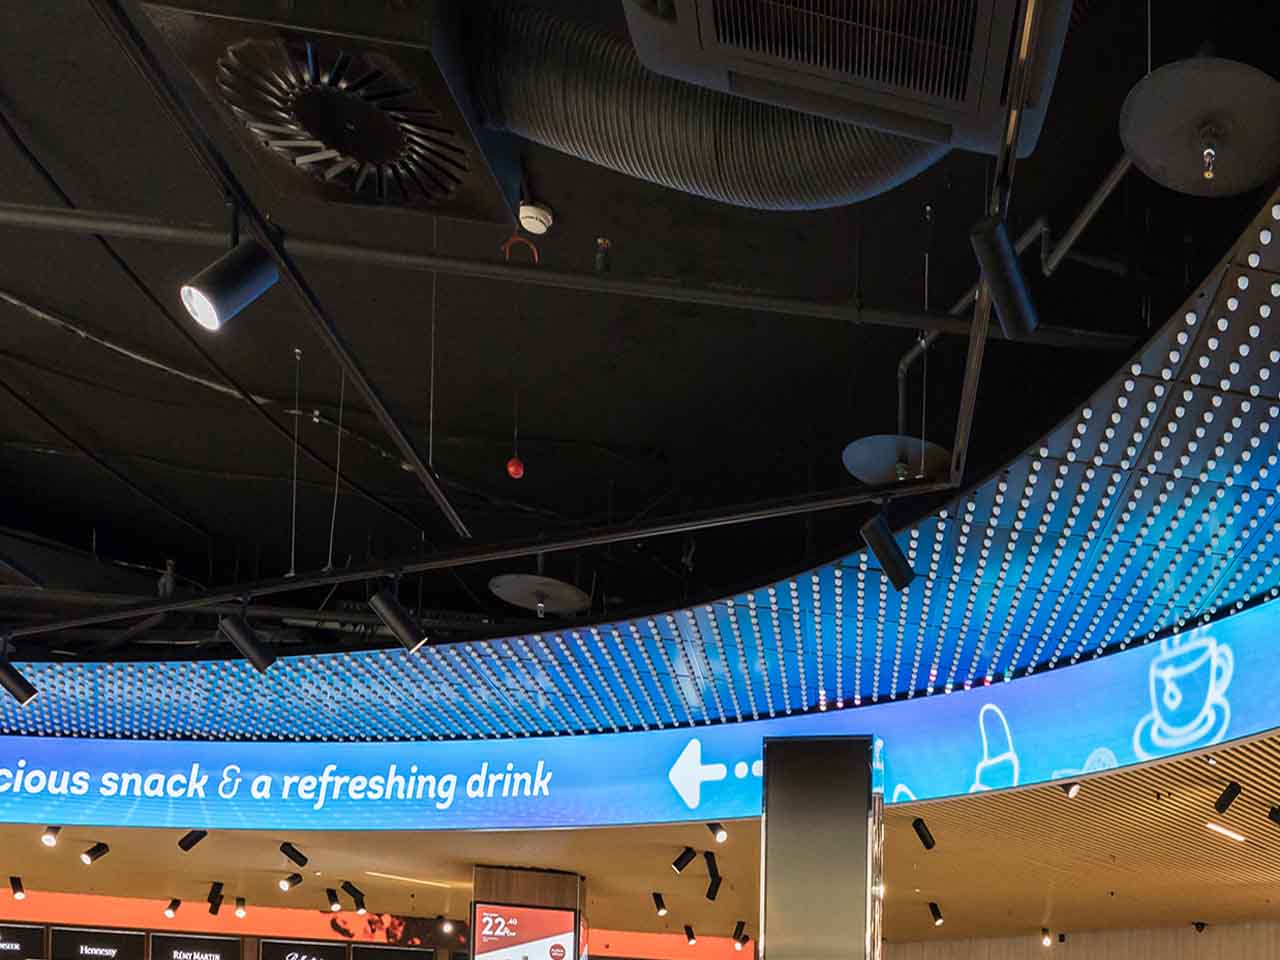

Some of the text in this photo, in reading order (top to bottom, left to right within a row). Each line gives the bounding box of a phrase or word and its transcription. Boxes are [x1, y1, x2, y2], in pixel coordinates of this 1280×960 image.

[99, 763, 209, 799] snack
[217, 764, 242, 799] &
[251, 774, 273, 799] a
[281, 763, 458, 811] refreshing
[466, 760, 553, 798] drink
[79, 945, 118, 958] Hennessy
